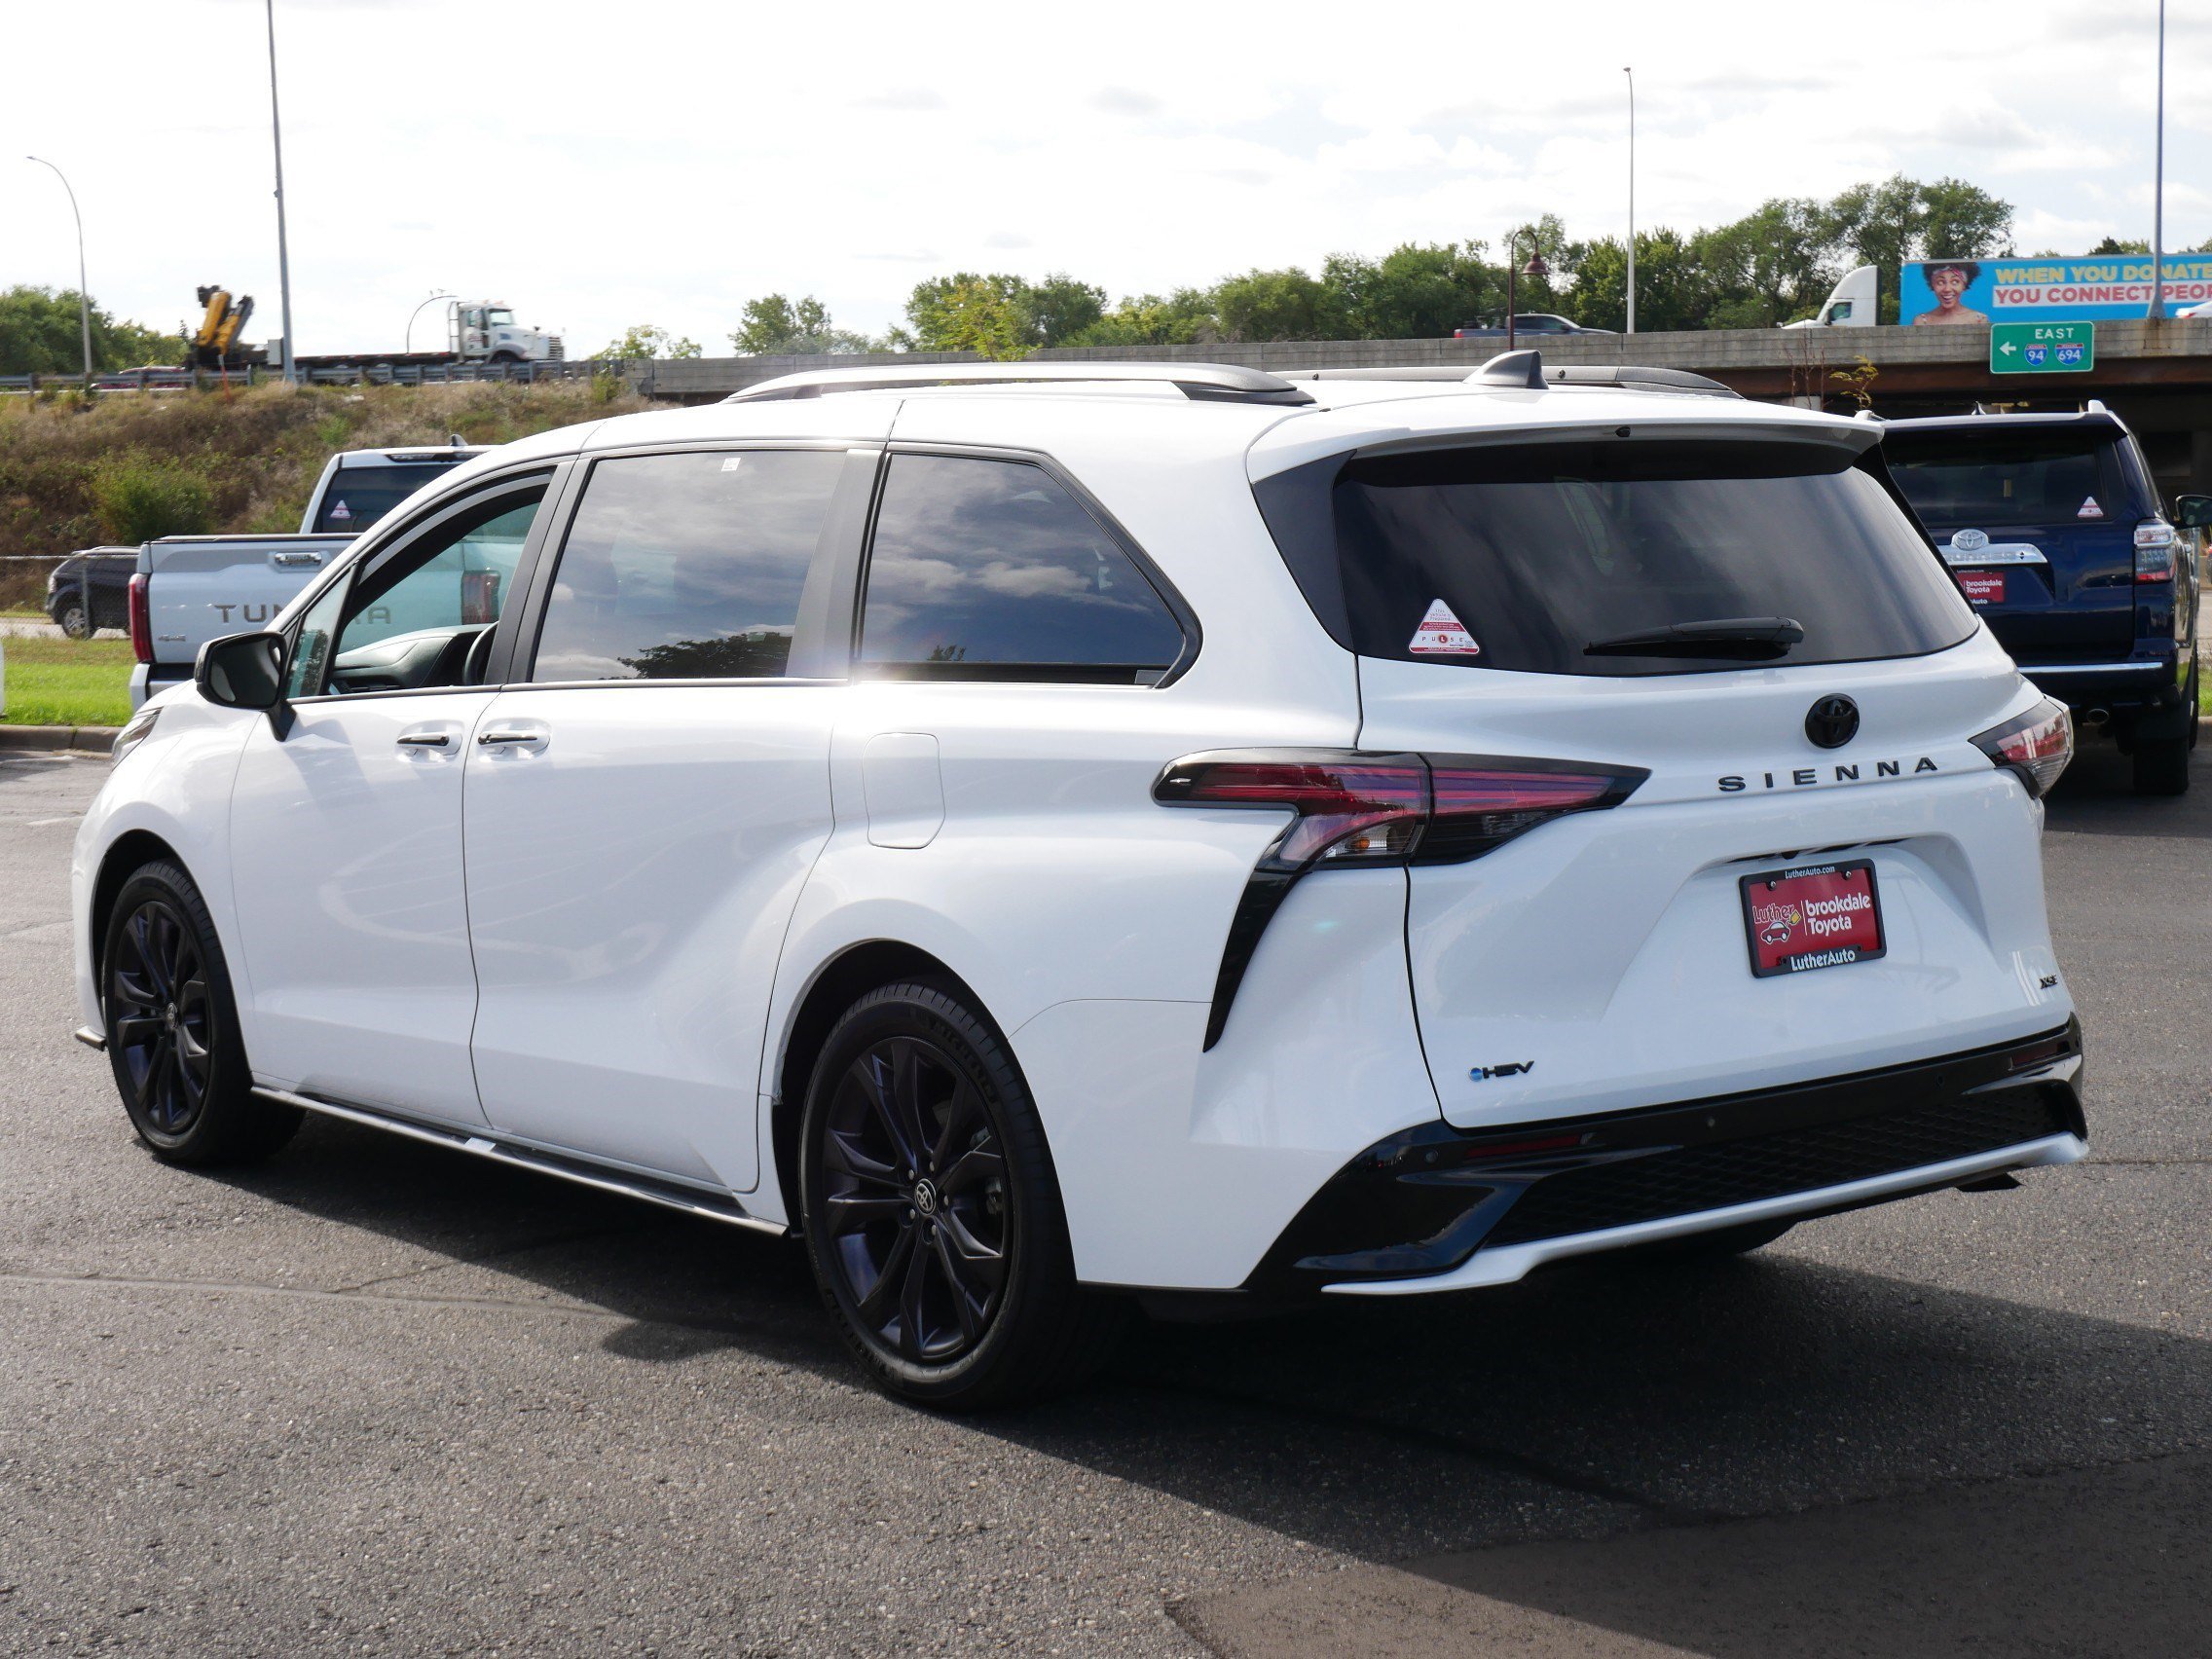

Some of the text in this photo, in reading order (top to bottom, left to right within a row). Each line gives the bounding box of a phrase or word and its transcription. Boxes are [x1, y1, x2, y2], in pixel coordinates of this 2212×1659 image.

[1995, 267, 2065, 284] WHEN
[2071, 265, 2119, 282] YOU
[1995, 288, 2041, 304] YOU
[2046, 285, 2153, 303] CONNECT
[2035, 327, 2075, 340] EAST
[2028, 350, 2081, 361] 94 694
[1717, 756, 1938, 793] SIENNA
[1785, 866, 1835, 880] LutherAuto.com
[1752, 903, 1795, 924] Luther
[1805, 892, 1871, 917] brookdale
[1808, 915, 1853, 937] Toyota
[1790, 948, 1856, 972] LutherAuto
[1482, 1060, 1535, 1080] HEV
